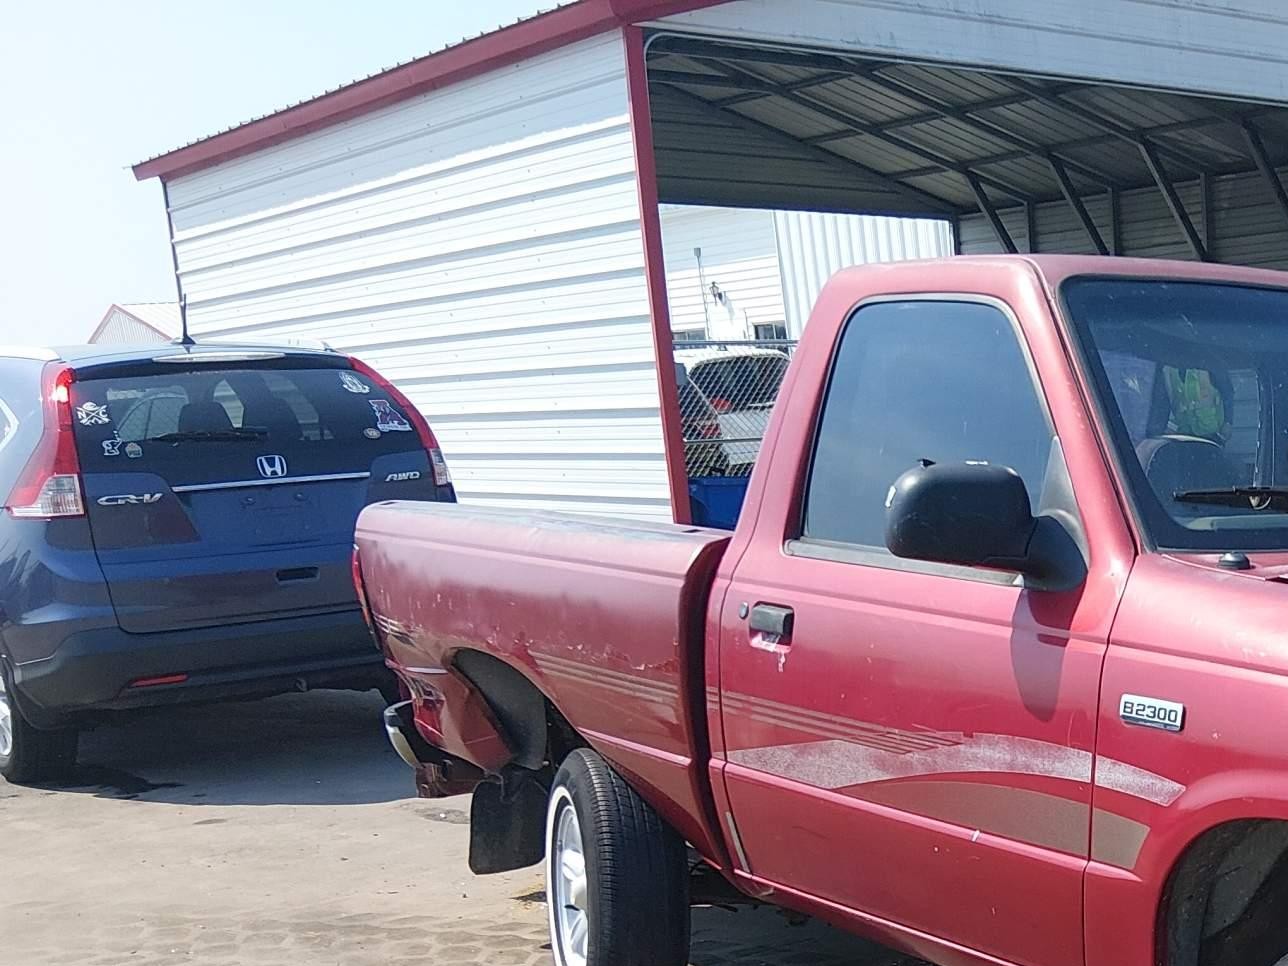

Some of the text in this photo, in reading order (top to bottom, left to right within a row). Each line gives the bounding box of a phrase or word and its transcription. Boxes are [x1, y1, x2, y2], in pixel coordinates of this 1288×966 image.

[385, 471, 420, 482] AWD
[97, 493, 163, 506] CR-V
[1123, 701, 1178, 722] B2300
